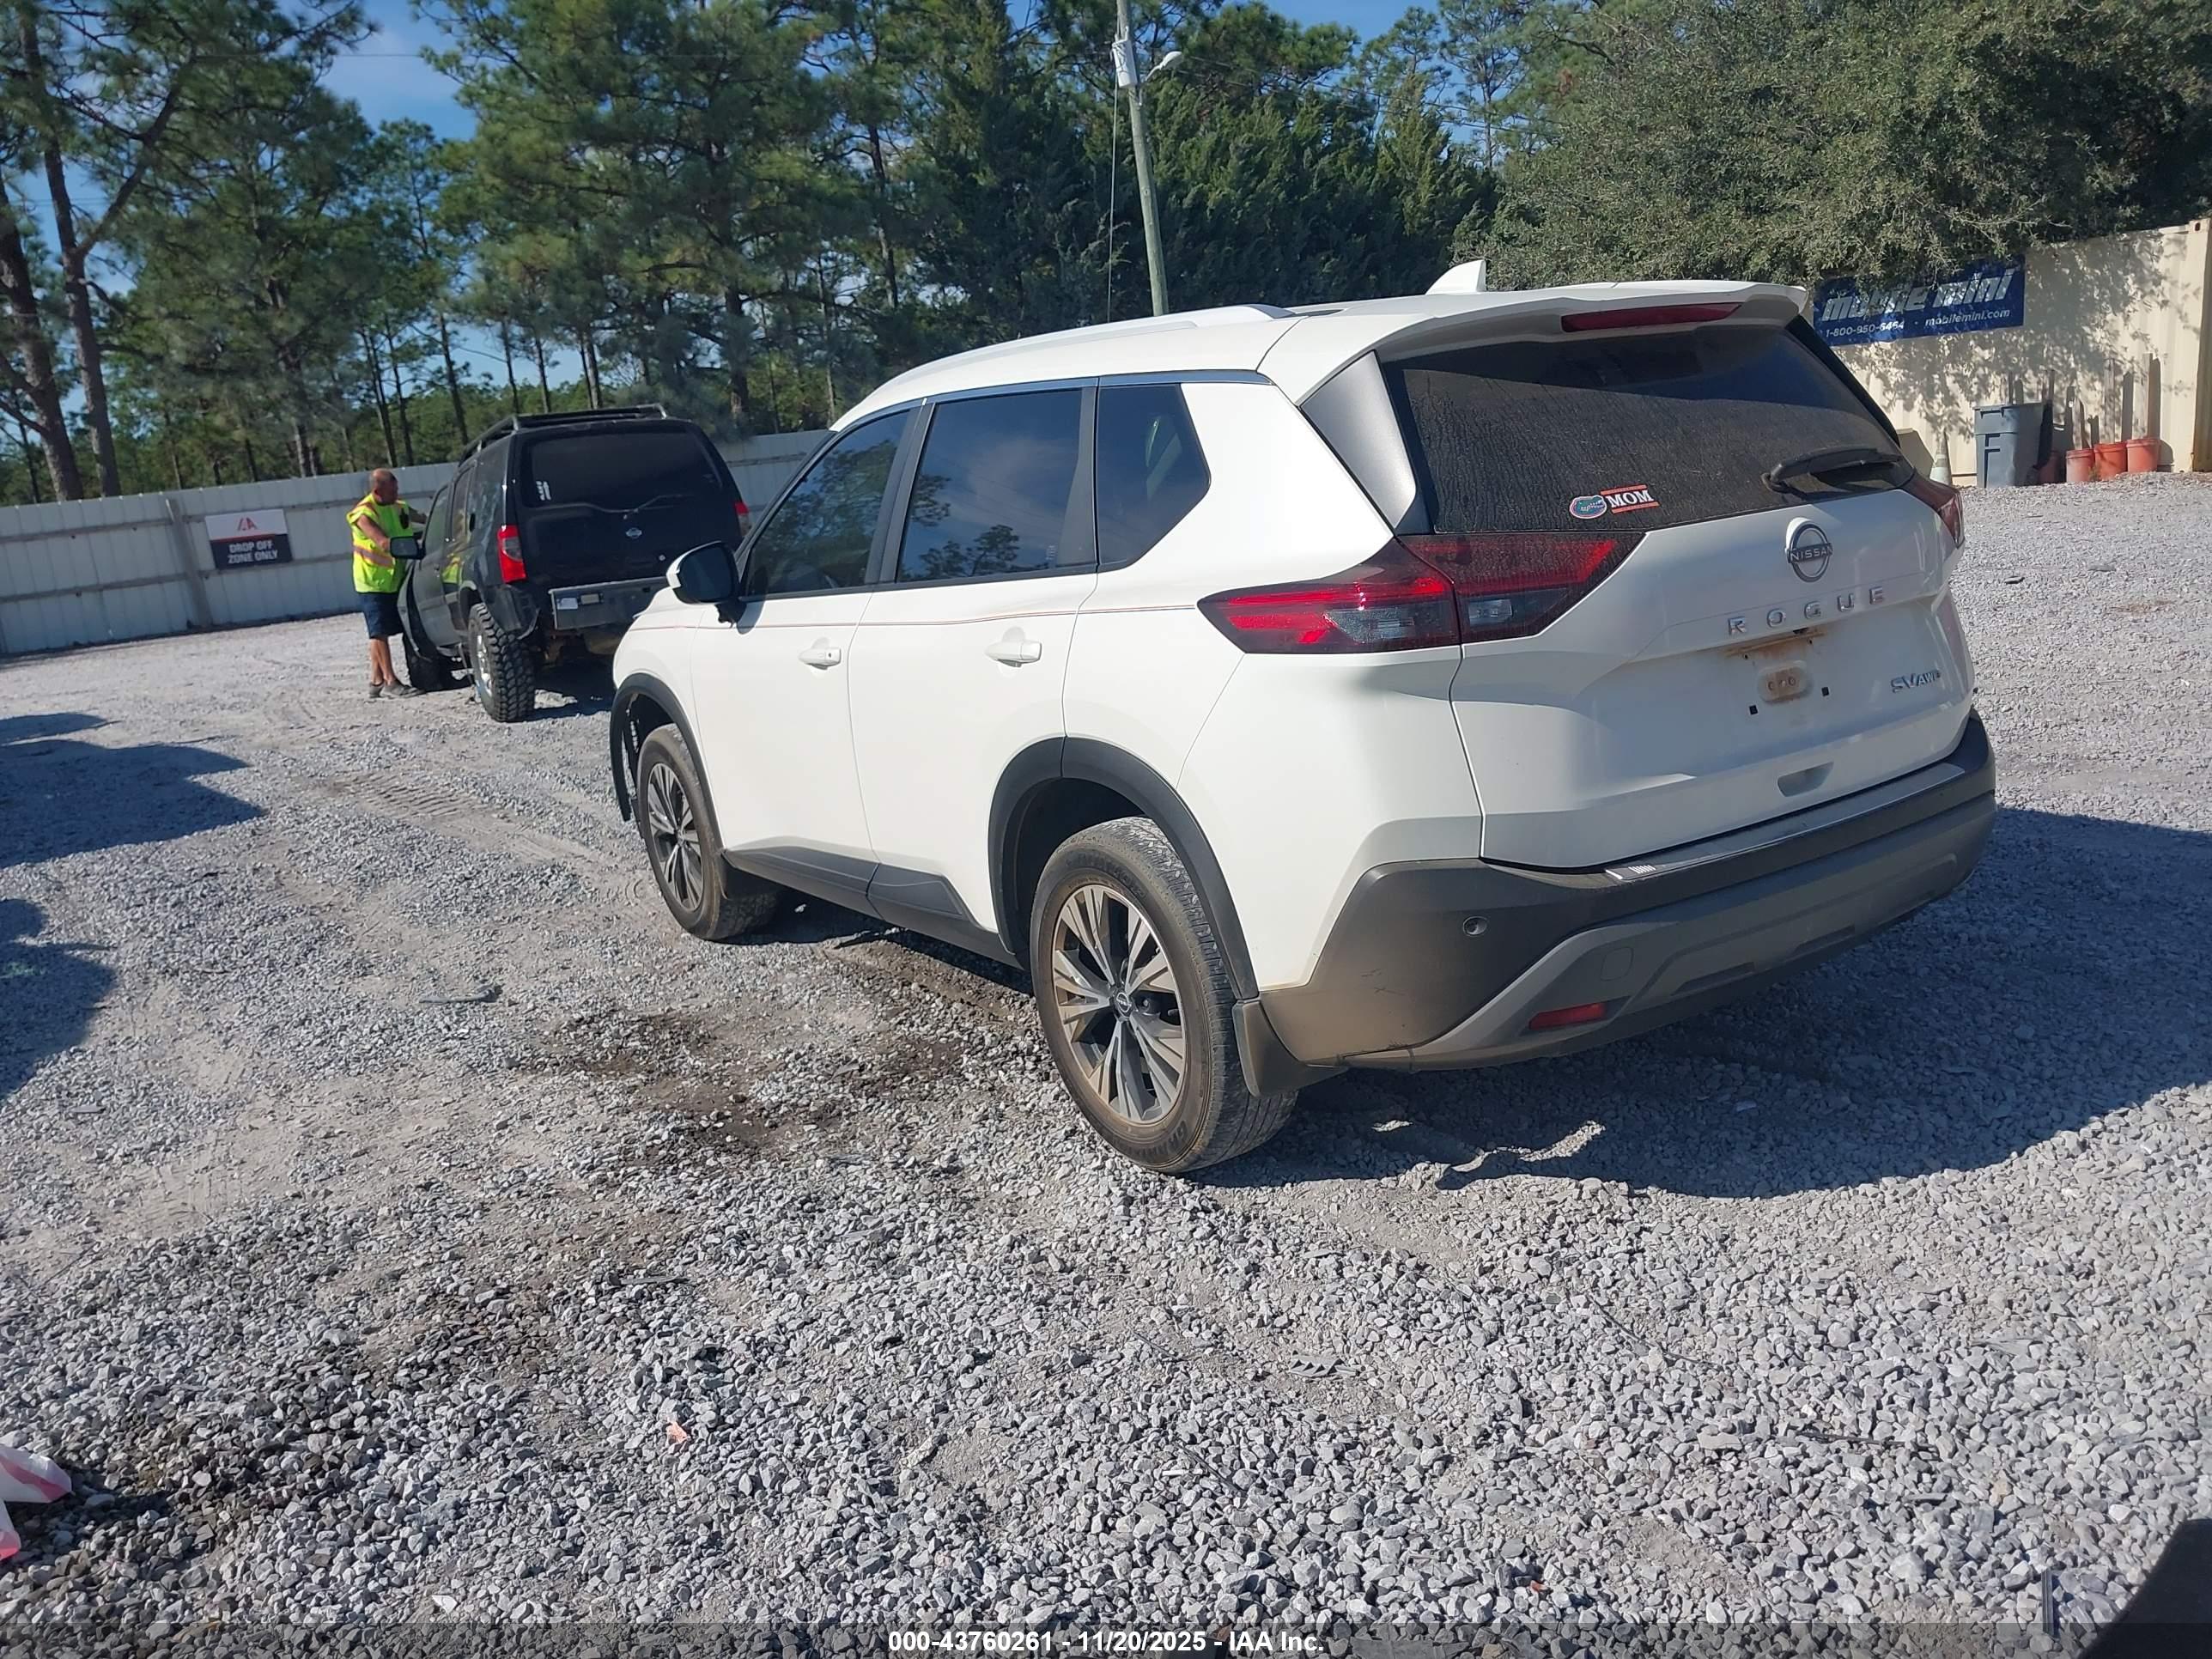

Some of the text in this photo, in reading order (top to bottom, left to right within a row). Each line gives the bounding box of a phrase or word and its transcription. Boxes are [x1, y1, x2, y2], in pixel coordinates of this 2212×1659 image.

[1932, 269, 2015, 307] mini
[1925, 309, 2010, 326] mobilemini.com
[1605, 489, 1654, 508] MOM
[228, 539, 273, 553] DROP OFF
[1790, 544, 1833, 562] NISSAN
[228, 550, 278, 563] ZONE ONLY
[1728, 586, 1885, 635] ROGUE
